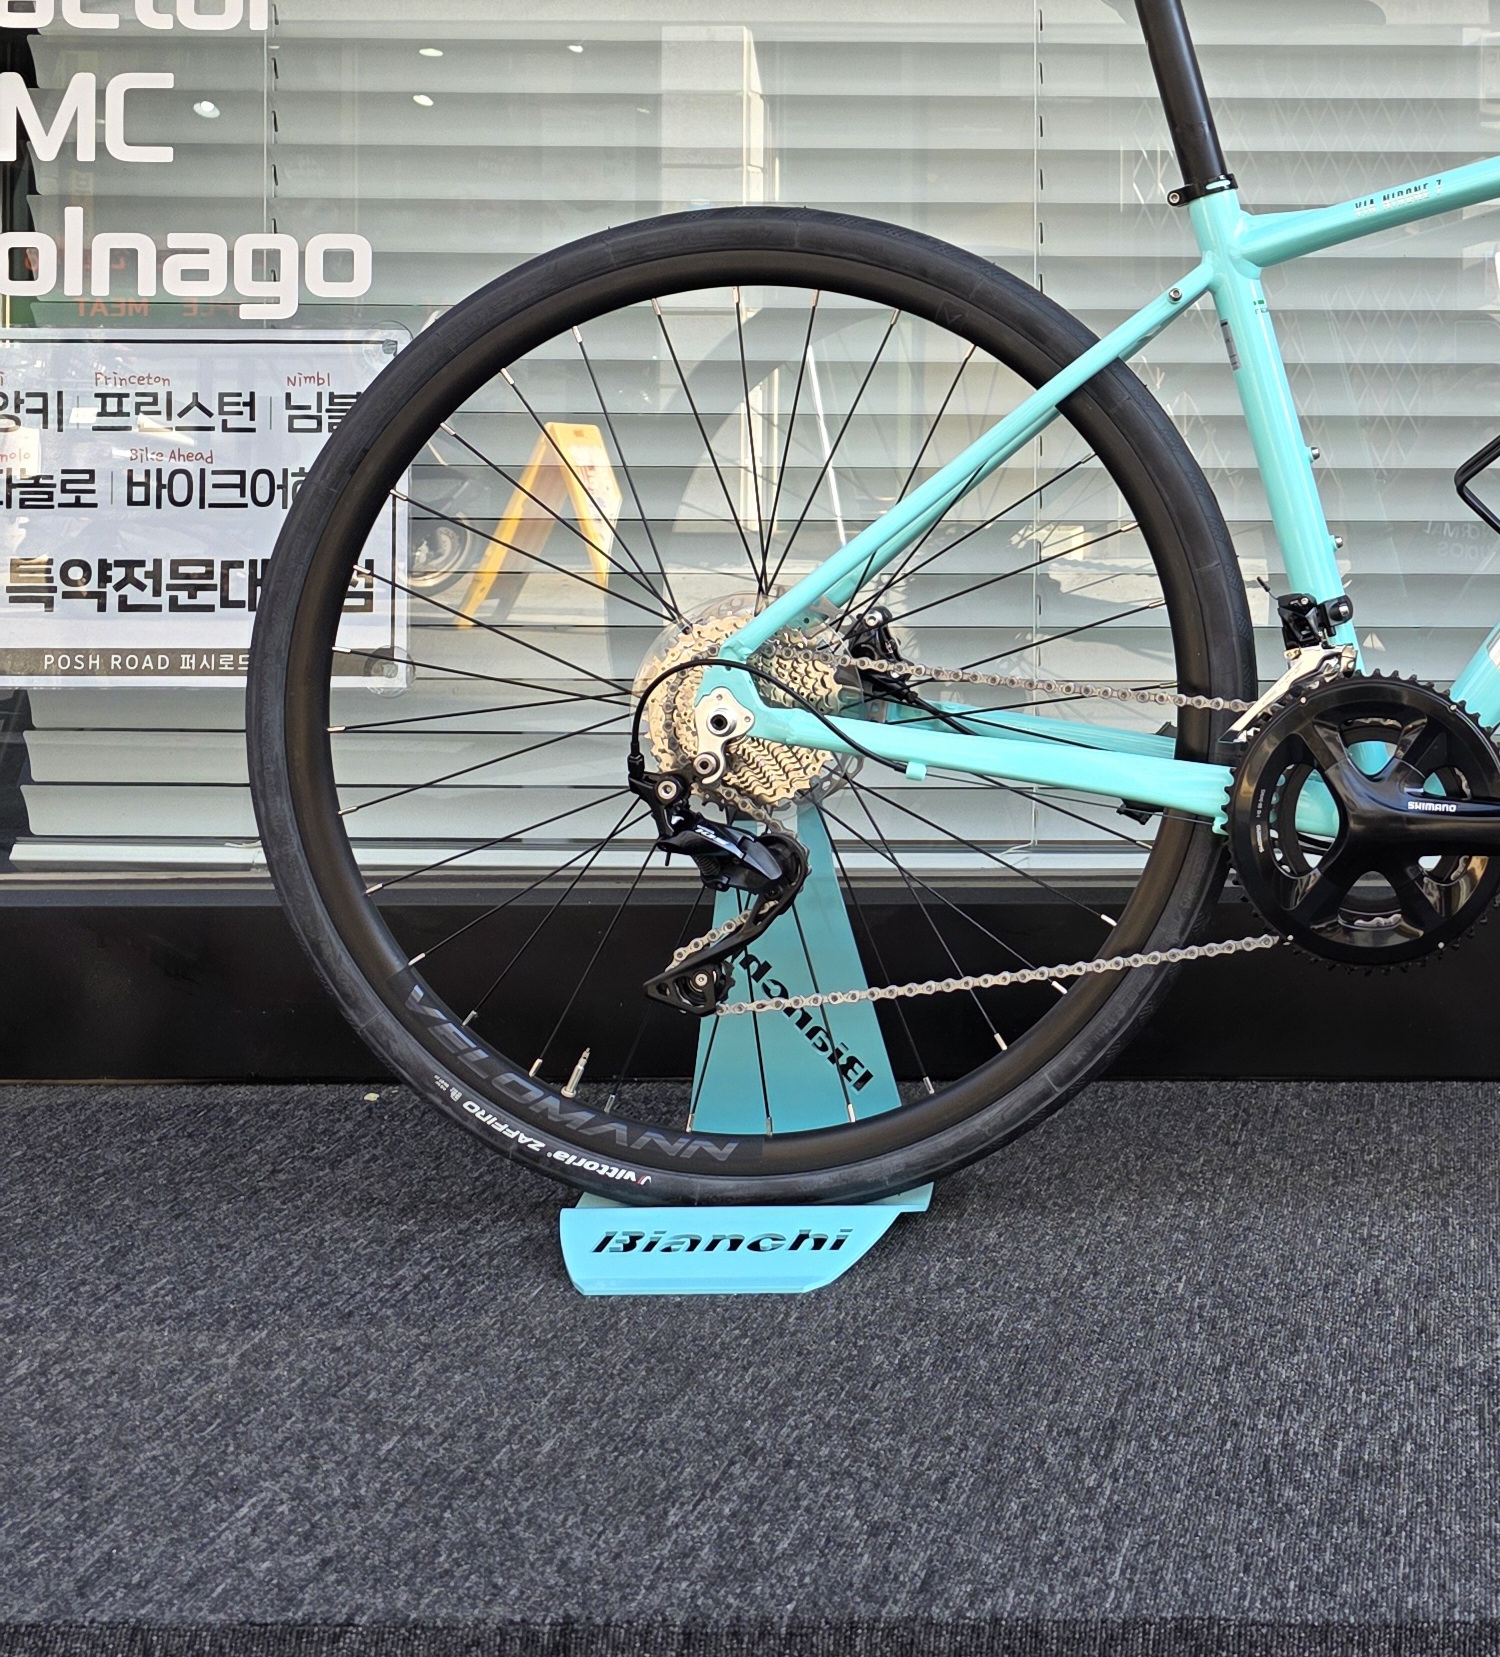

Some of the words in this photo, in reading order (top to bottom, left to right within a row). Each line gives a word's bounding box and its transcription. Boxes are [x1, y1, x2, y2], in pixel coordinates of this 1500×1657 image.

[94, 372, 171, 387] Princeton
[287, 372, 331, 387] Nimbl
[92, 390, 256, 433] 프리스턴
[168, 448, 214, 465] Ahead
[44, 653, 101, 671] POSH
[111, 653, 170, 671] ROAD
[1407, 801, 1457, 813] SHIMANO
[405, 985, 738, 1161] VELOMANN
[462, 1100, 546, 1152] ZAFFIRO
[552, 1150, 639, 1183] vittoria
[591, 1228, 854, 1253] Bianchi
